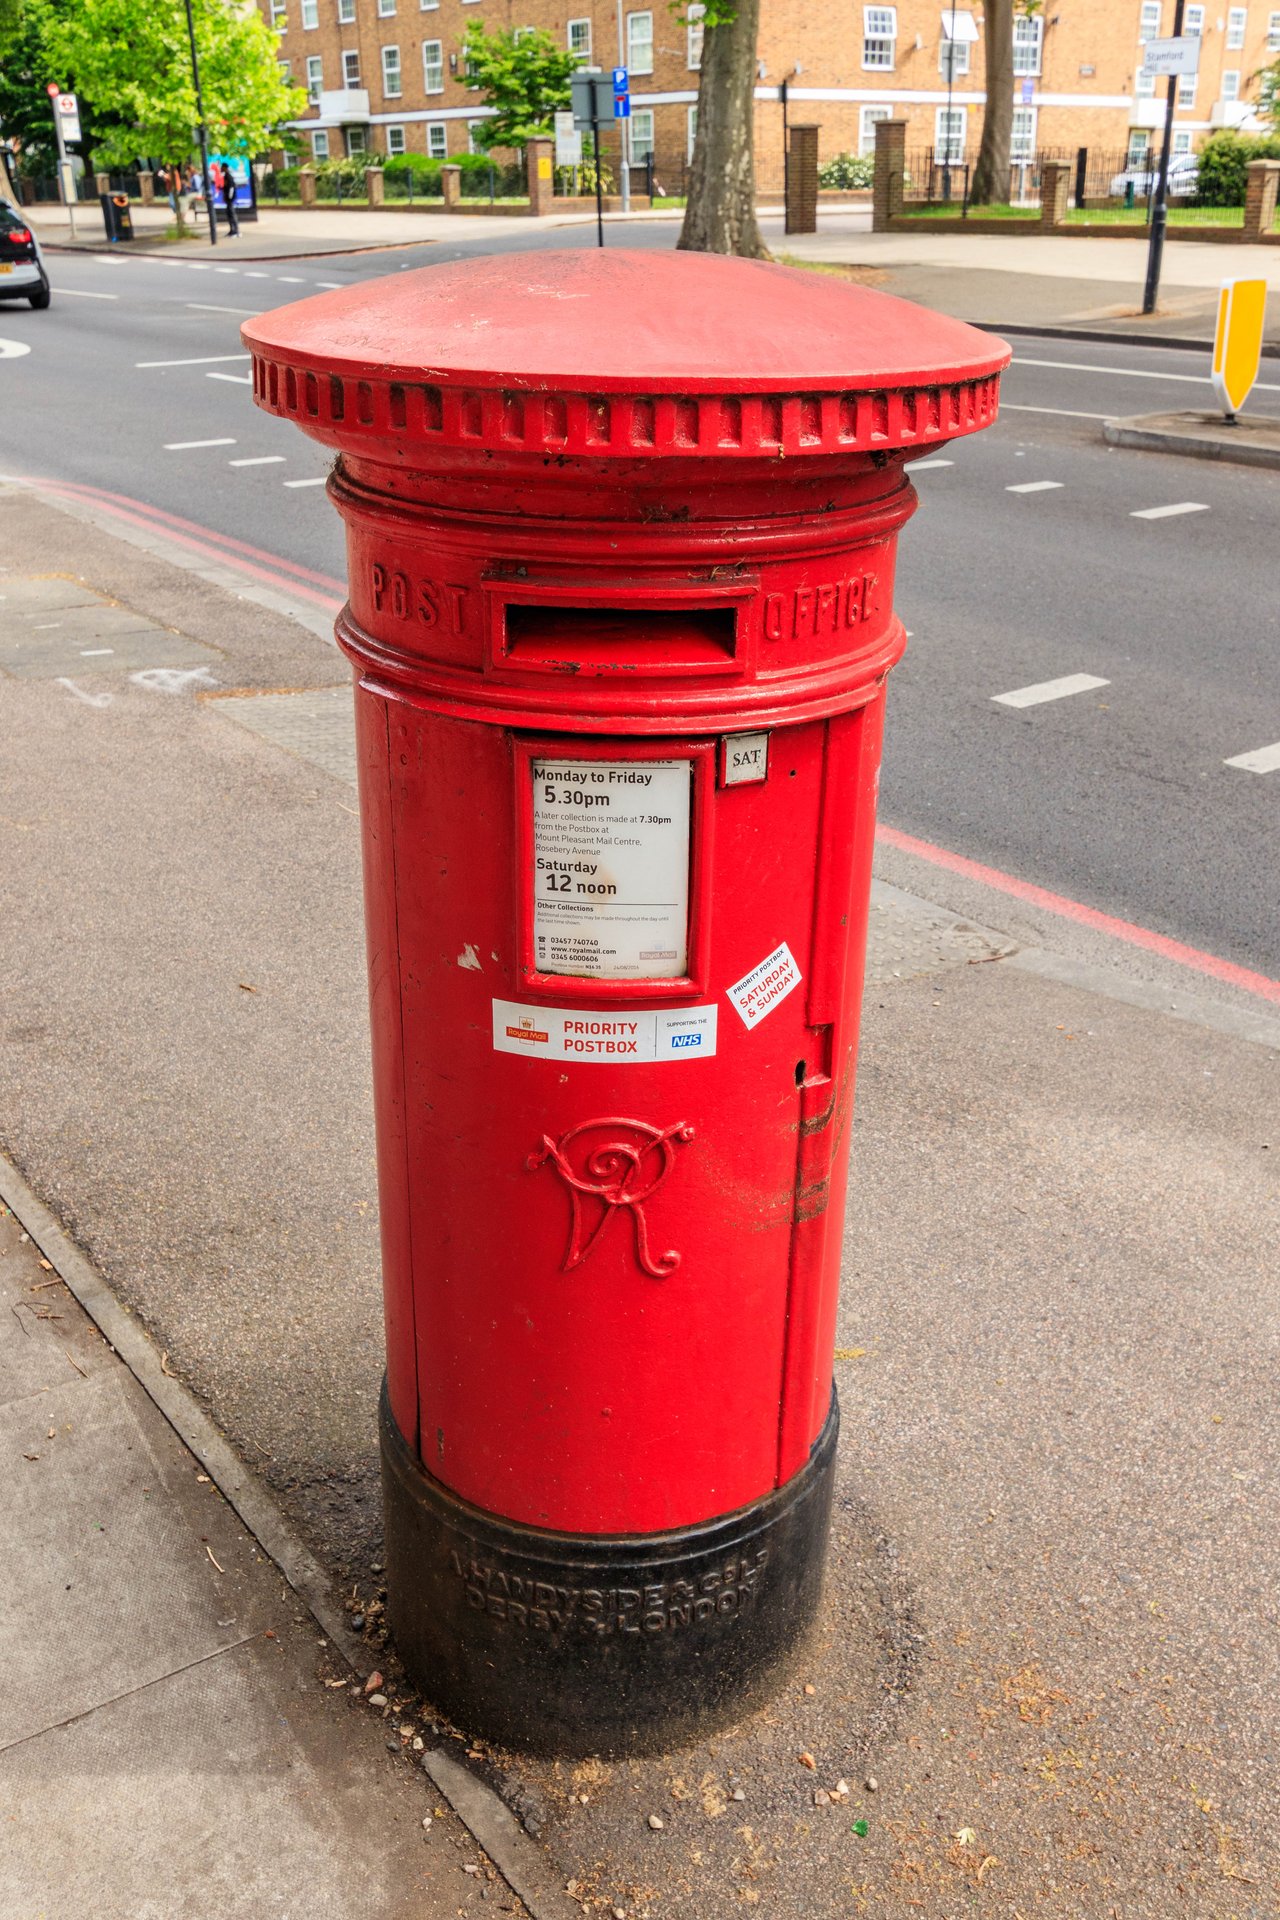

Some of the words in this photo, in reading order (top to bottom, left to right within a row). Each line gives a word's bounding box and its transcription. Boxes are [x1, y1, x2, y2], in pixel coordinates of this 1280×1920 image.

[372, 563, 470, 636] POST
[732, 749, 761, 768] SAT
[534, 768, 587, 784] Monday
[590, 773, 605, 783] to
[608, 771, 653, 786] Friday
[544, 785, 610, 808] 5.30pm
[541, 812, 559, 820] later
[560, 814, 597, 822] collection
[629, 816, 638, 824] at
[639, 816, 672, 826] 7.30pm
[534, 822, 554, 831] from
[554, 824, 567, 832] the
[568, 824, 600, 834] Postbox
[535, 833, 560, 842] Mount
[561, 834, 595, 844] Pleasant
[596, 836, 612, 845] Mail
[536, 844, 570, 856] Rosebery
[571, 846, 601, 856] Avenue
[536, 858, 598, 876] Saturday
[546, 873, 572, 892] 12
[576, 882, 617, 895] noon
[537, 902, 556, 910] Other
[557, 903, 594, 912] Collections
[550, 937, 572, 945] 03457
[573, 938, 599, 946] 740740
[550, 946, 617, 955] www.royalmail.com
[569, 954, 599, 962] 6000606
[733, 971, 759, 995] PRIORITY
[760, 949, 784, 973] POSTBOX
[740, 958, 790, 1008] SATURDAY
[748, 1008, 756, 1018] &
[756, 970, 794, 1010] SUNDAY
[564, 1020, 638, 1035] PRIORITY
[666, 1020, 697, 1028] SUPPORTING
[508, 1028, 529, 1038] Royal
[530, 1032, 547, 1040] Mail
[673, 1034, 700, 1047] NHS
[564, 1038, 637, 1053] POSTBOX
[615, 1583, 756, 1632] LONDON
